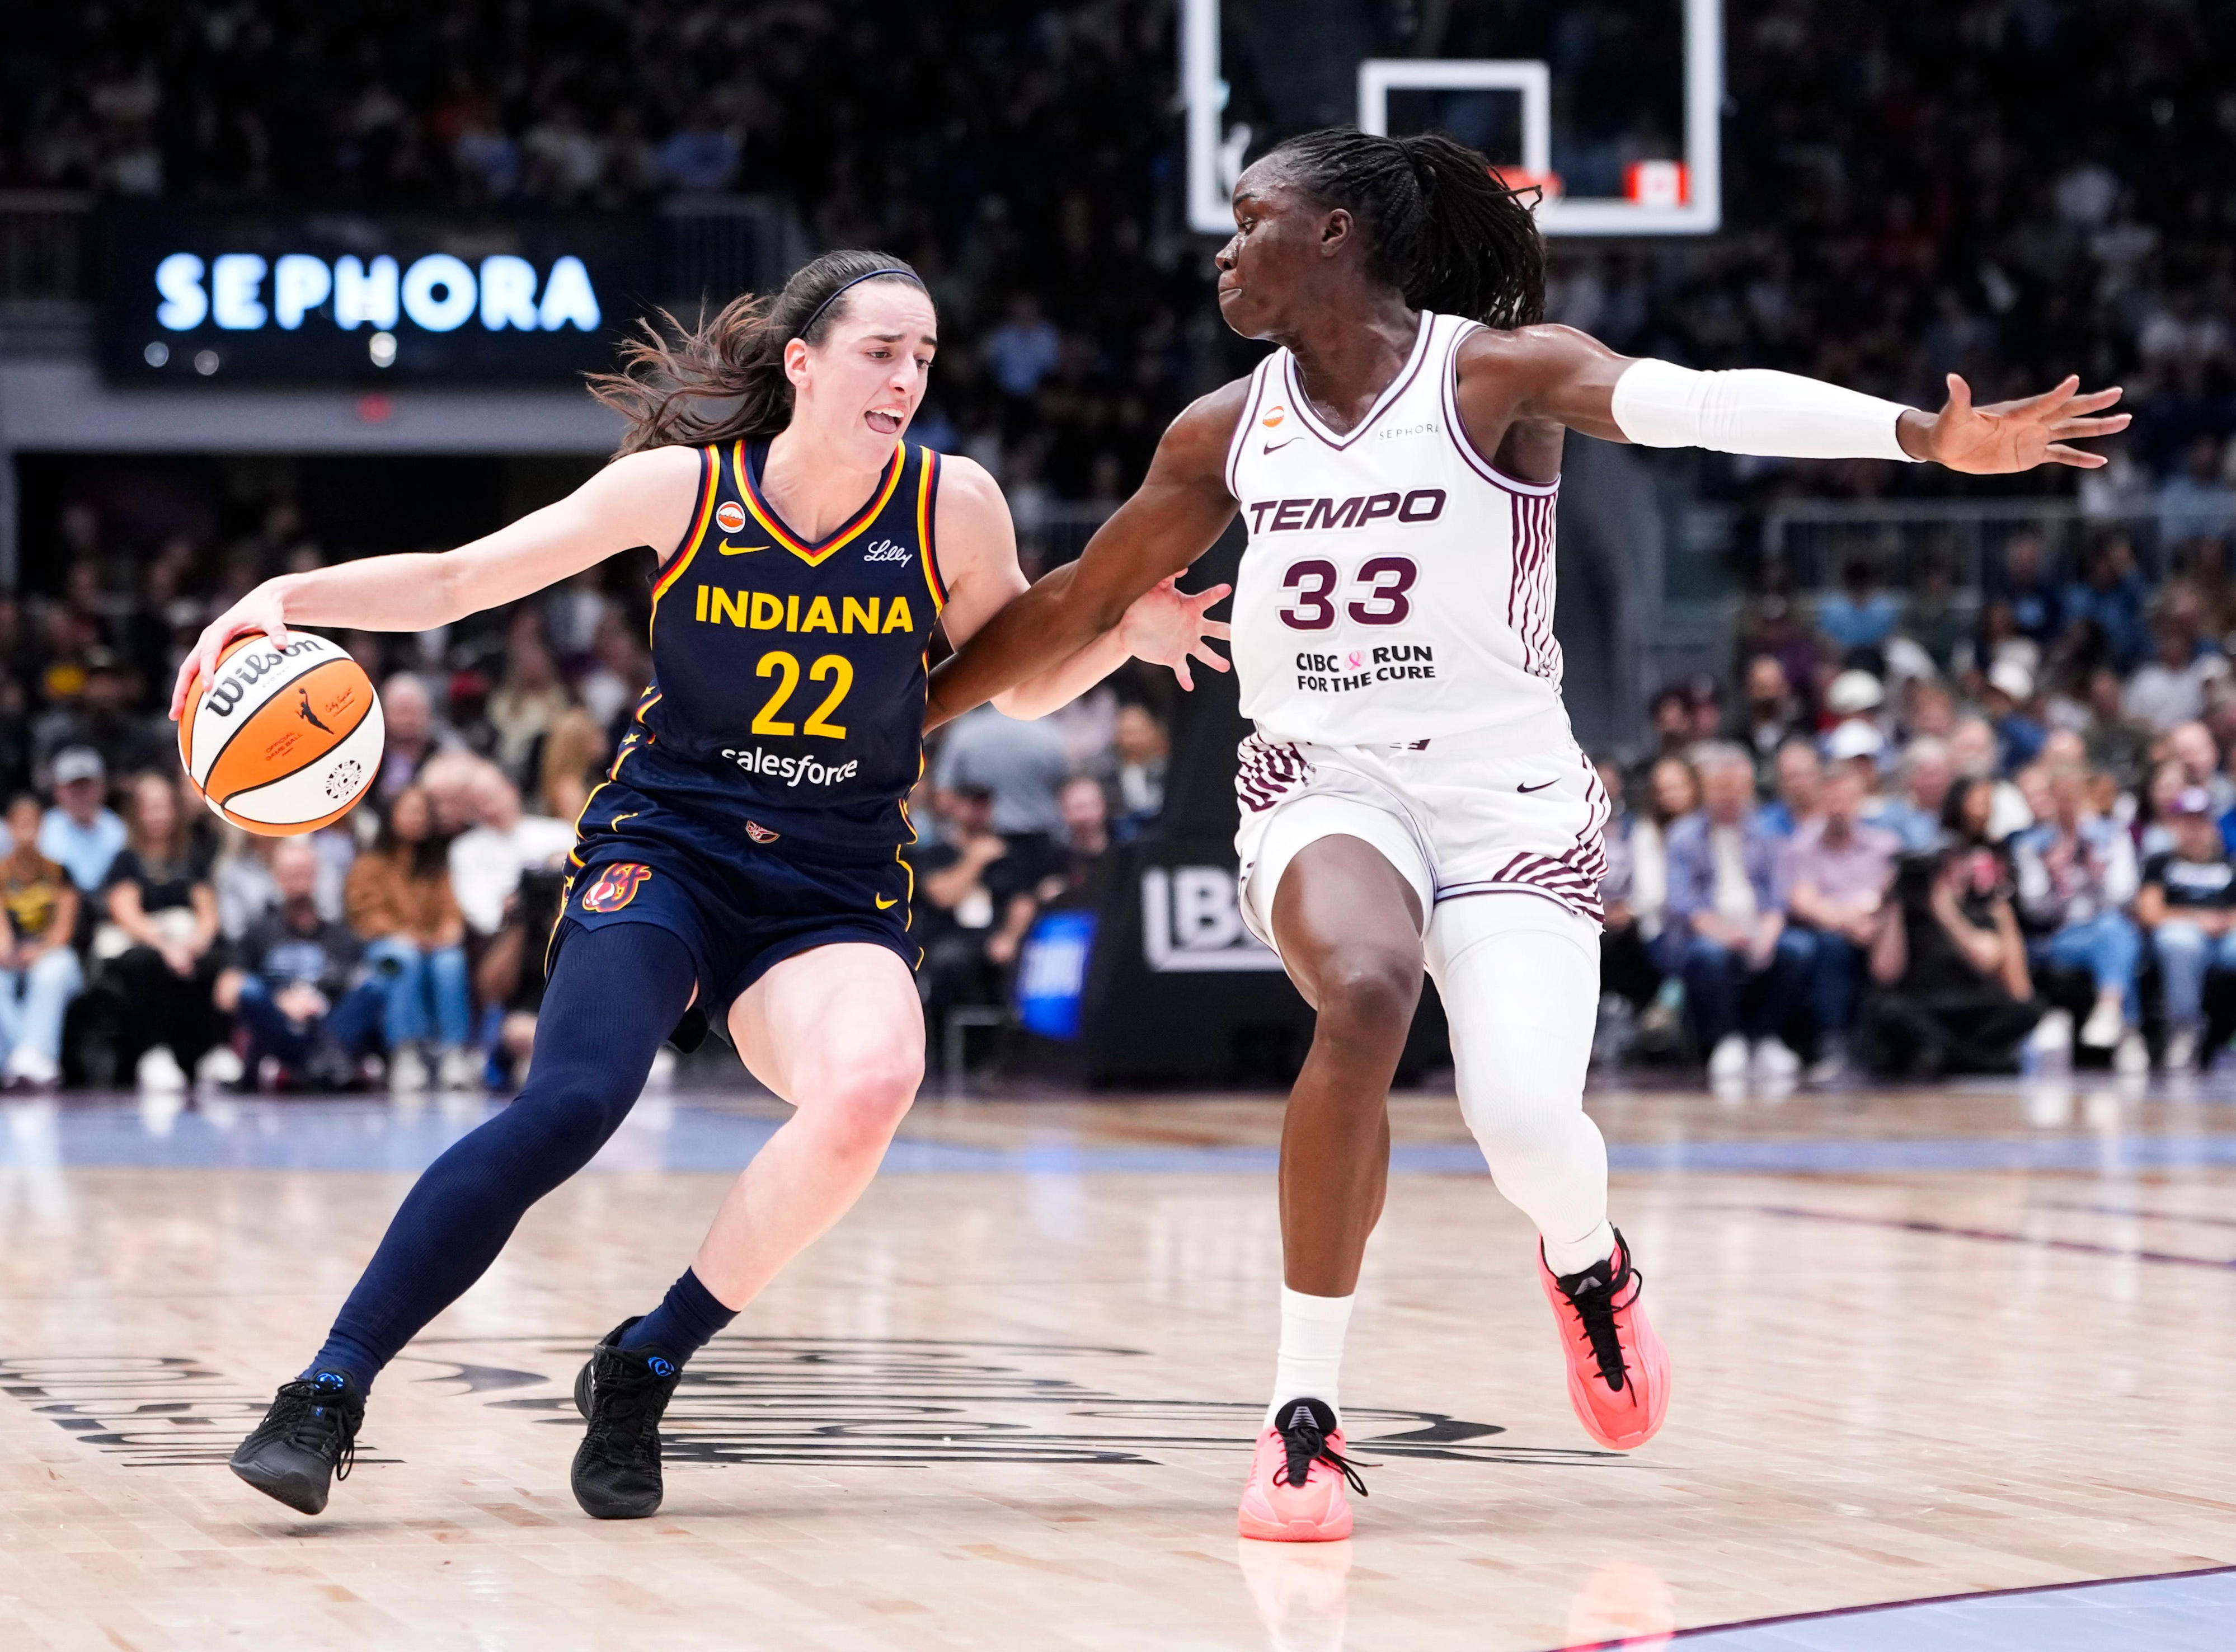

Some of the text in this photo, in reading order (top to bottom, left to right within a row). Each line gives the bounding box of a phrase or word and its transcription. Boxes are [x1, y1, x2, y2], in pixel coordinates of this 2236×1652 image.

[156, 253, 600, 331] SEPHORA
[1249, 489, 1447, 535] TEMPO
[863, 539, 913, 568] Lilly
[696, 584, 914, 634] INDIANA
[1279, 557, 1417, 630] 33
[205, 640, 325, 717] Wilson
[1296, 645, 1433, 673] CIBC RUN
[1297, 666, 1436, 692] FOR THE CURE
[751, 650, 854, 739] 22
[285, 734, 303, 747] BALL
[721, 747, 858, 787] salesforce
